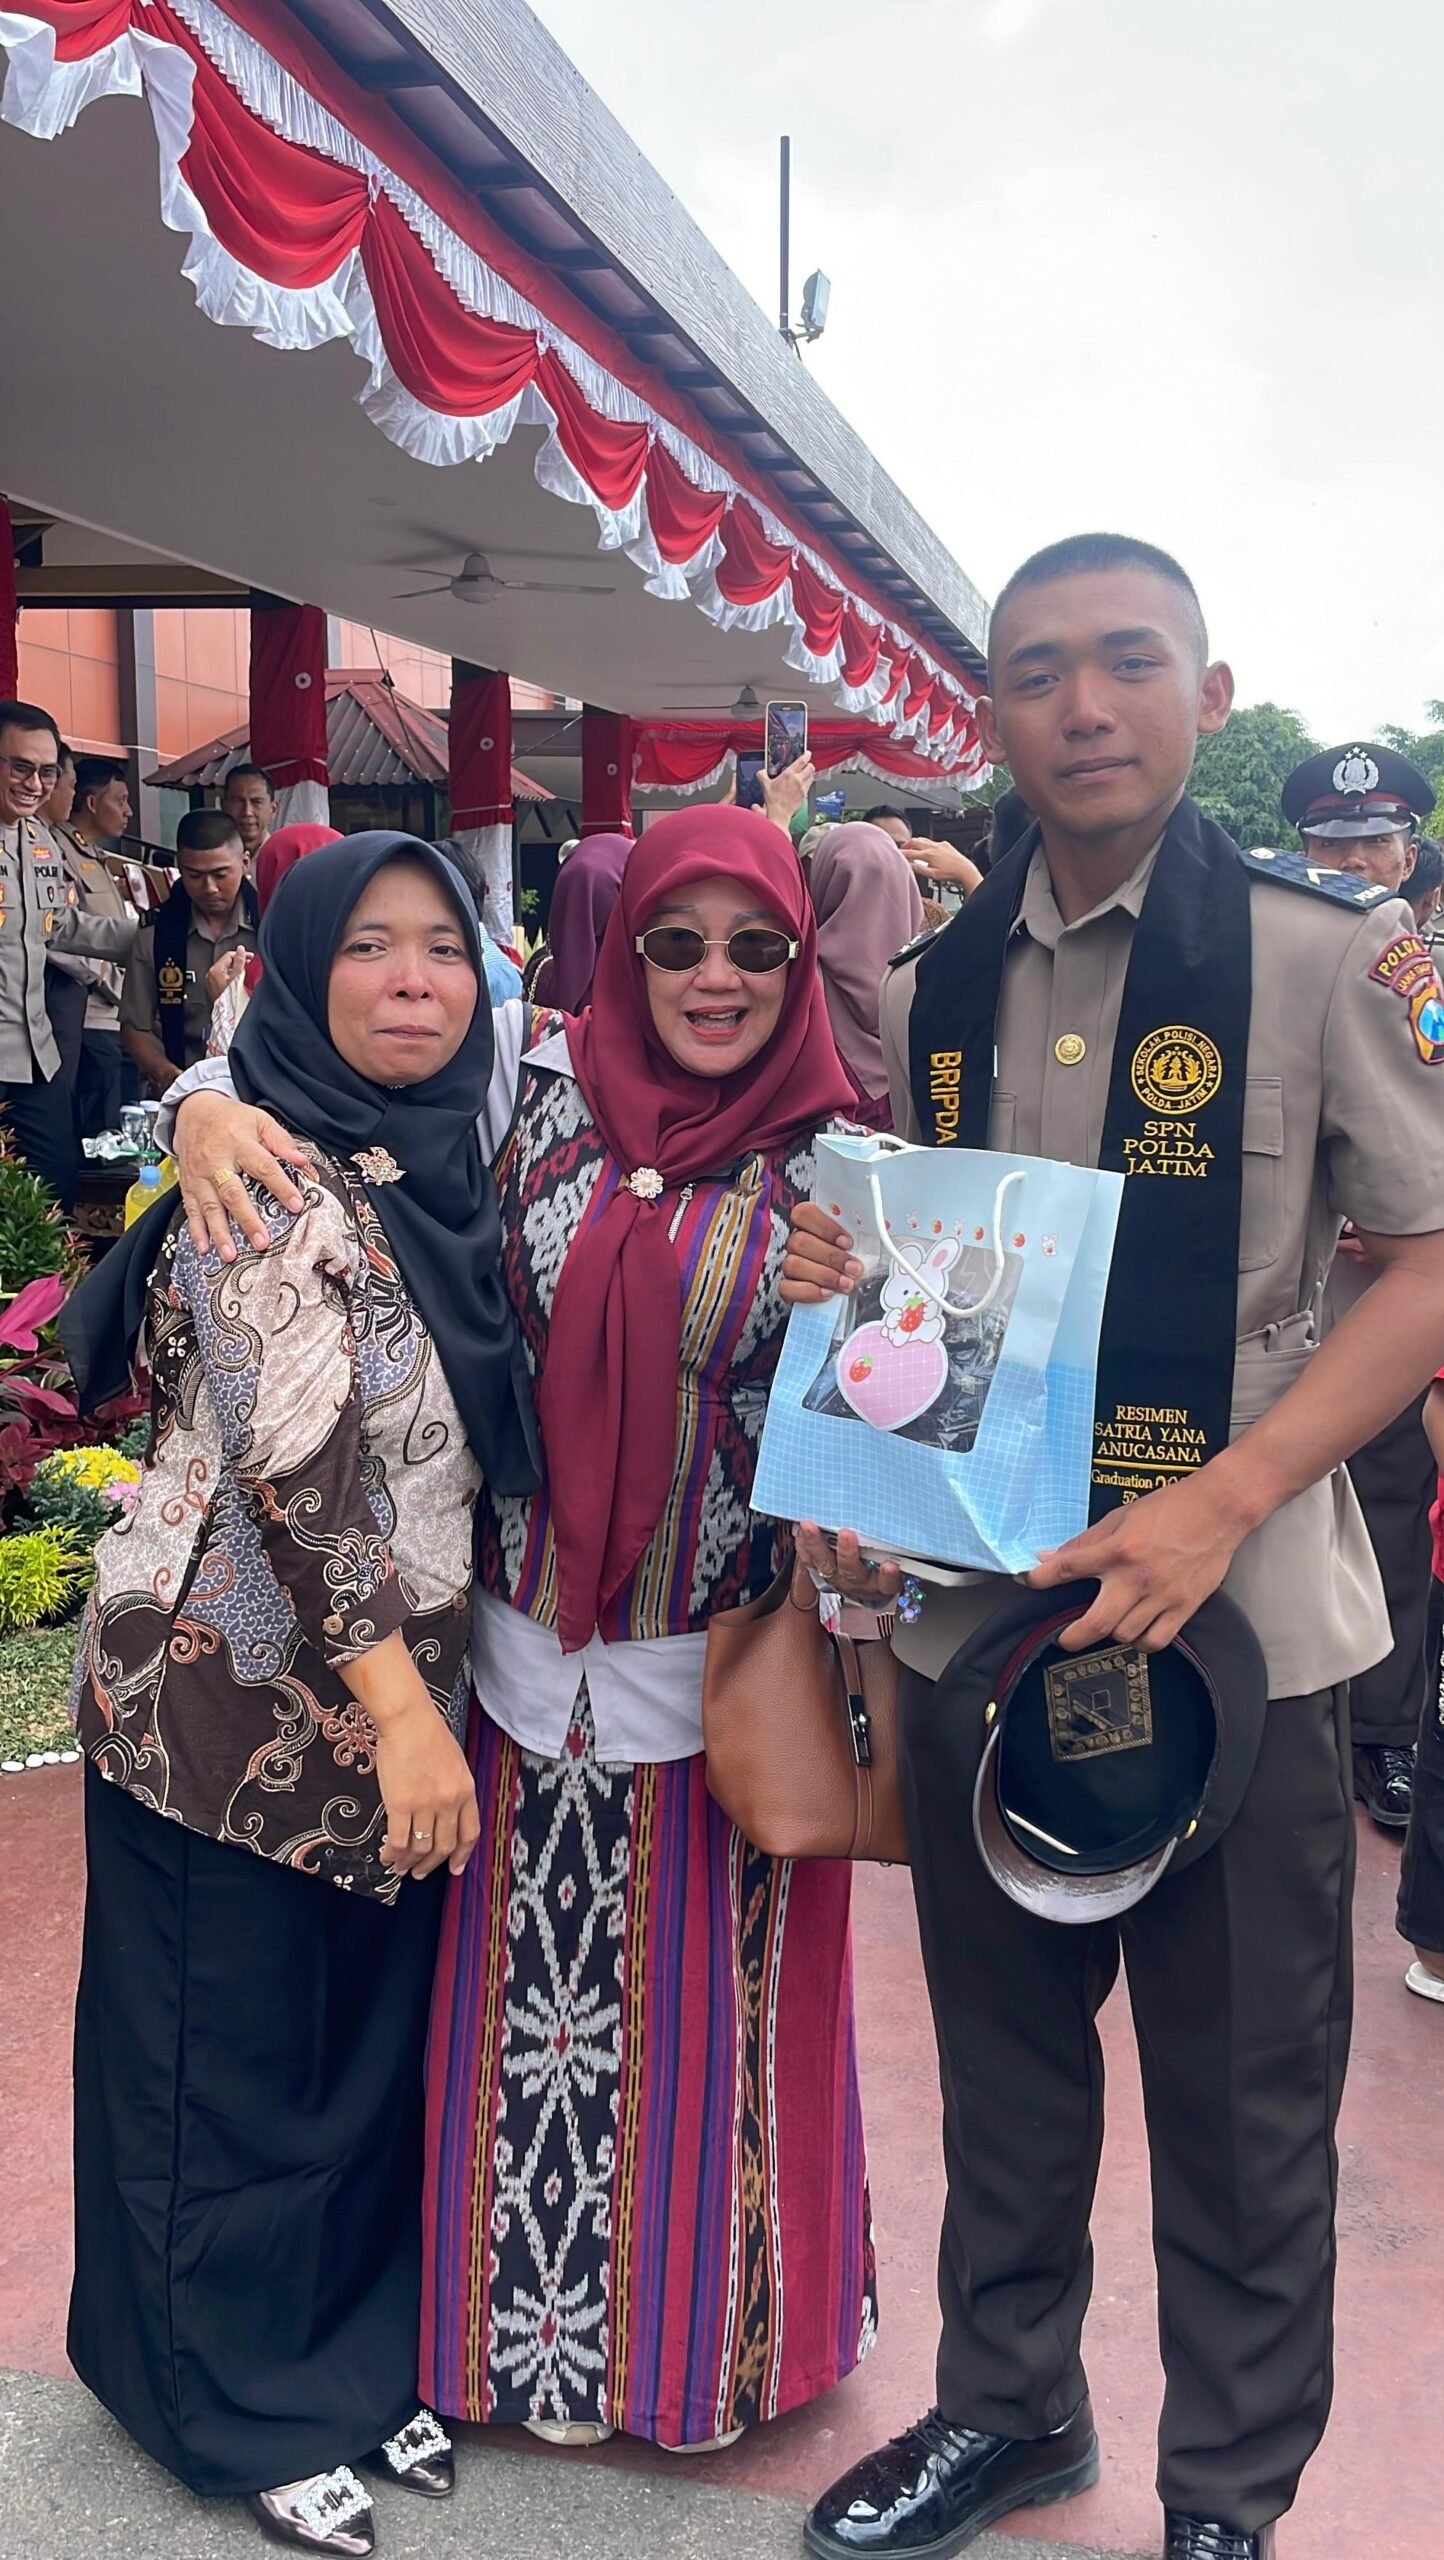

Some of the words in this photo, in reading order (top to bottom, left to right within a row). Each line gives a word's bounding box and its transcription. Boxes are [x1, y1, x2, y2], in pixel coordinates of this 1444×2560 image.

[1378, 939, 1422, 977] POLDA
[1135, 1036, 1162, 1076] SEKOLAH
[1163, 1030, 1197, 1043] POLISI
[1197, 1040, 1218, 1079] NEGARA
[930, 1051, 962, 1145] BRIPDA
[1141, 1087, 1172, 1110] POLDA
[1177, 1087, 1209, 1110] JATIM
[1143, 1120, 1197, 1138] SPN
[1123, 1139, 1215, 1159] POLDA
[1126, 1157, 1208, 1177] JATIM
[1115, 1404, 1188, 1424] RESIMEN
[1094, 1421, 1152, 1441] SATRIA
[1160, 1427, 1207, 1445] YANA
[1097, 1441, 1202, 1462] ANUCASANA
[1091, 1469, 1153, 1489] Graduation
